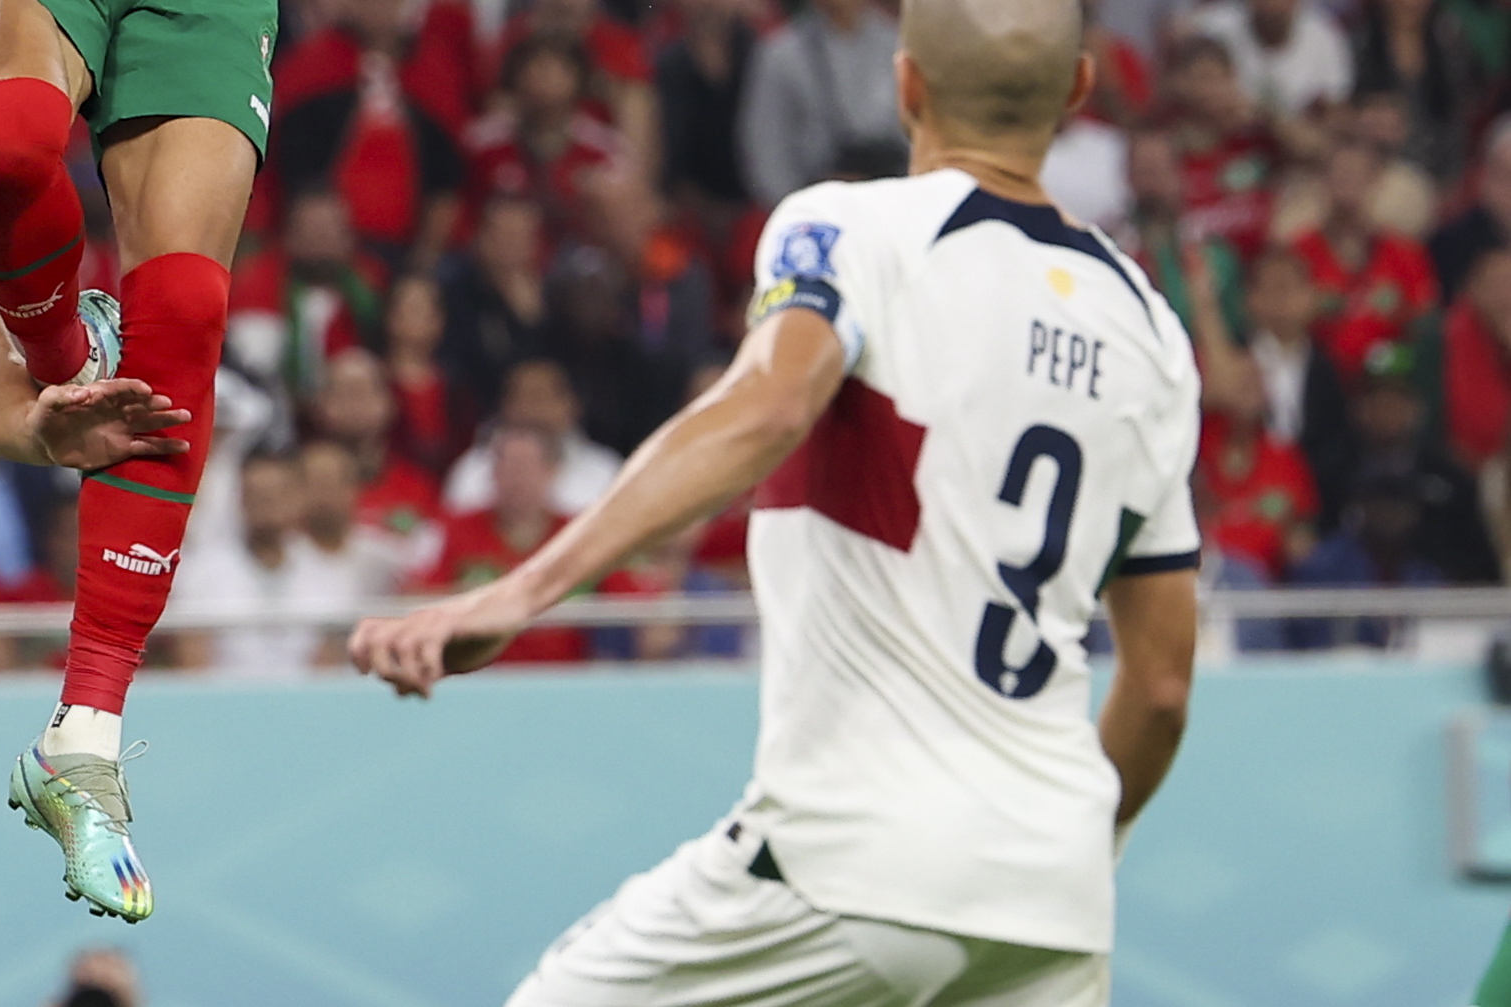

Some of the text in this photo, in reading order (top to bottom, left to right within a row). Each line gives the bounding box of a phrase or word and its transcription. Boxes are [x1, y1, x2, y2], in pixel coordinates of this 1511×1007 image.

[1027, 319, 1106, 401] PEPE
[101, 547, 163, 576] PUMA
[973, 422, 1084, 701] 3
